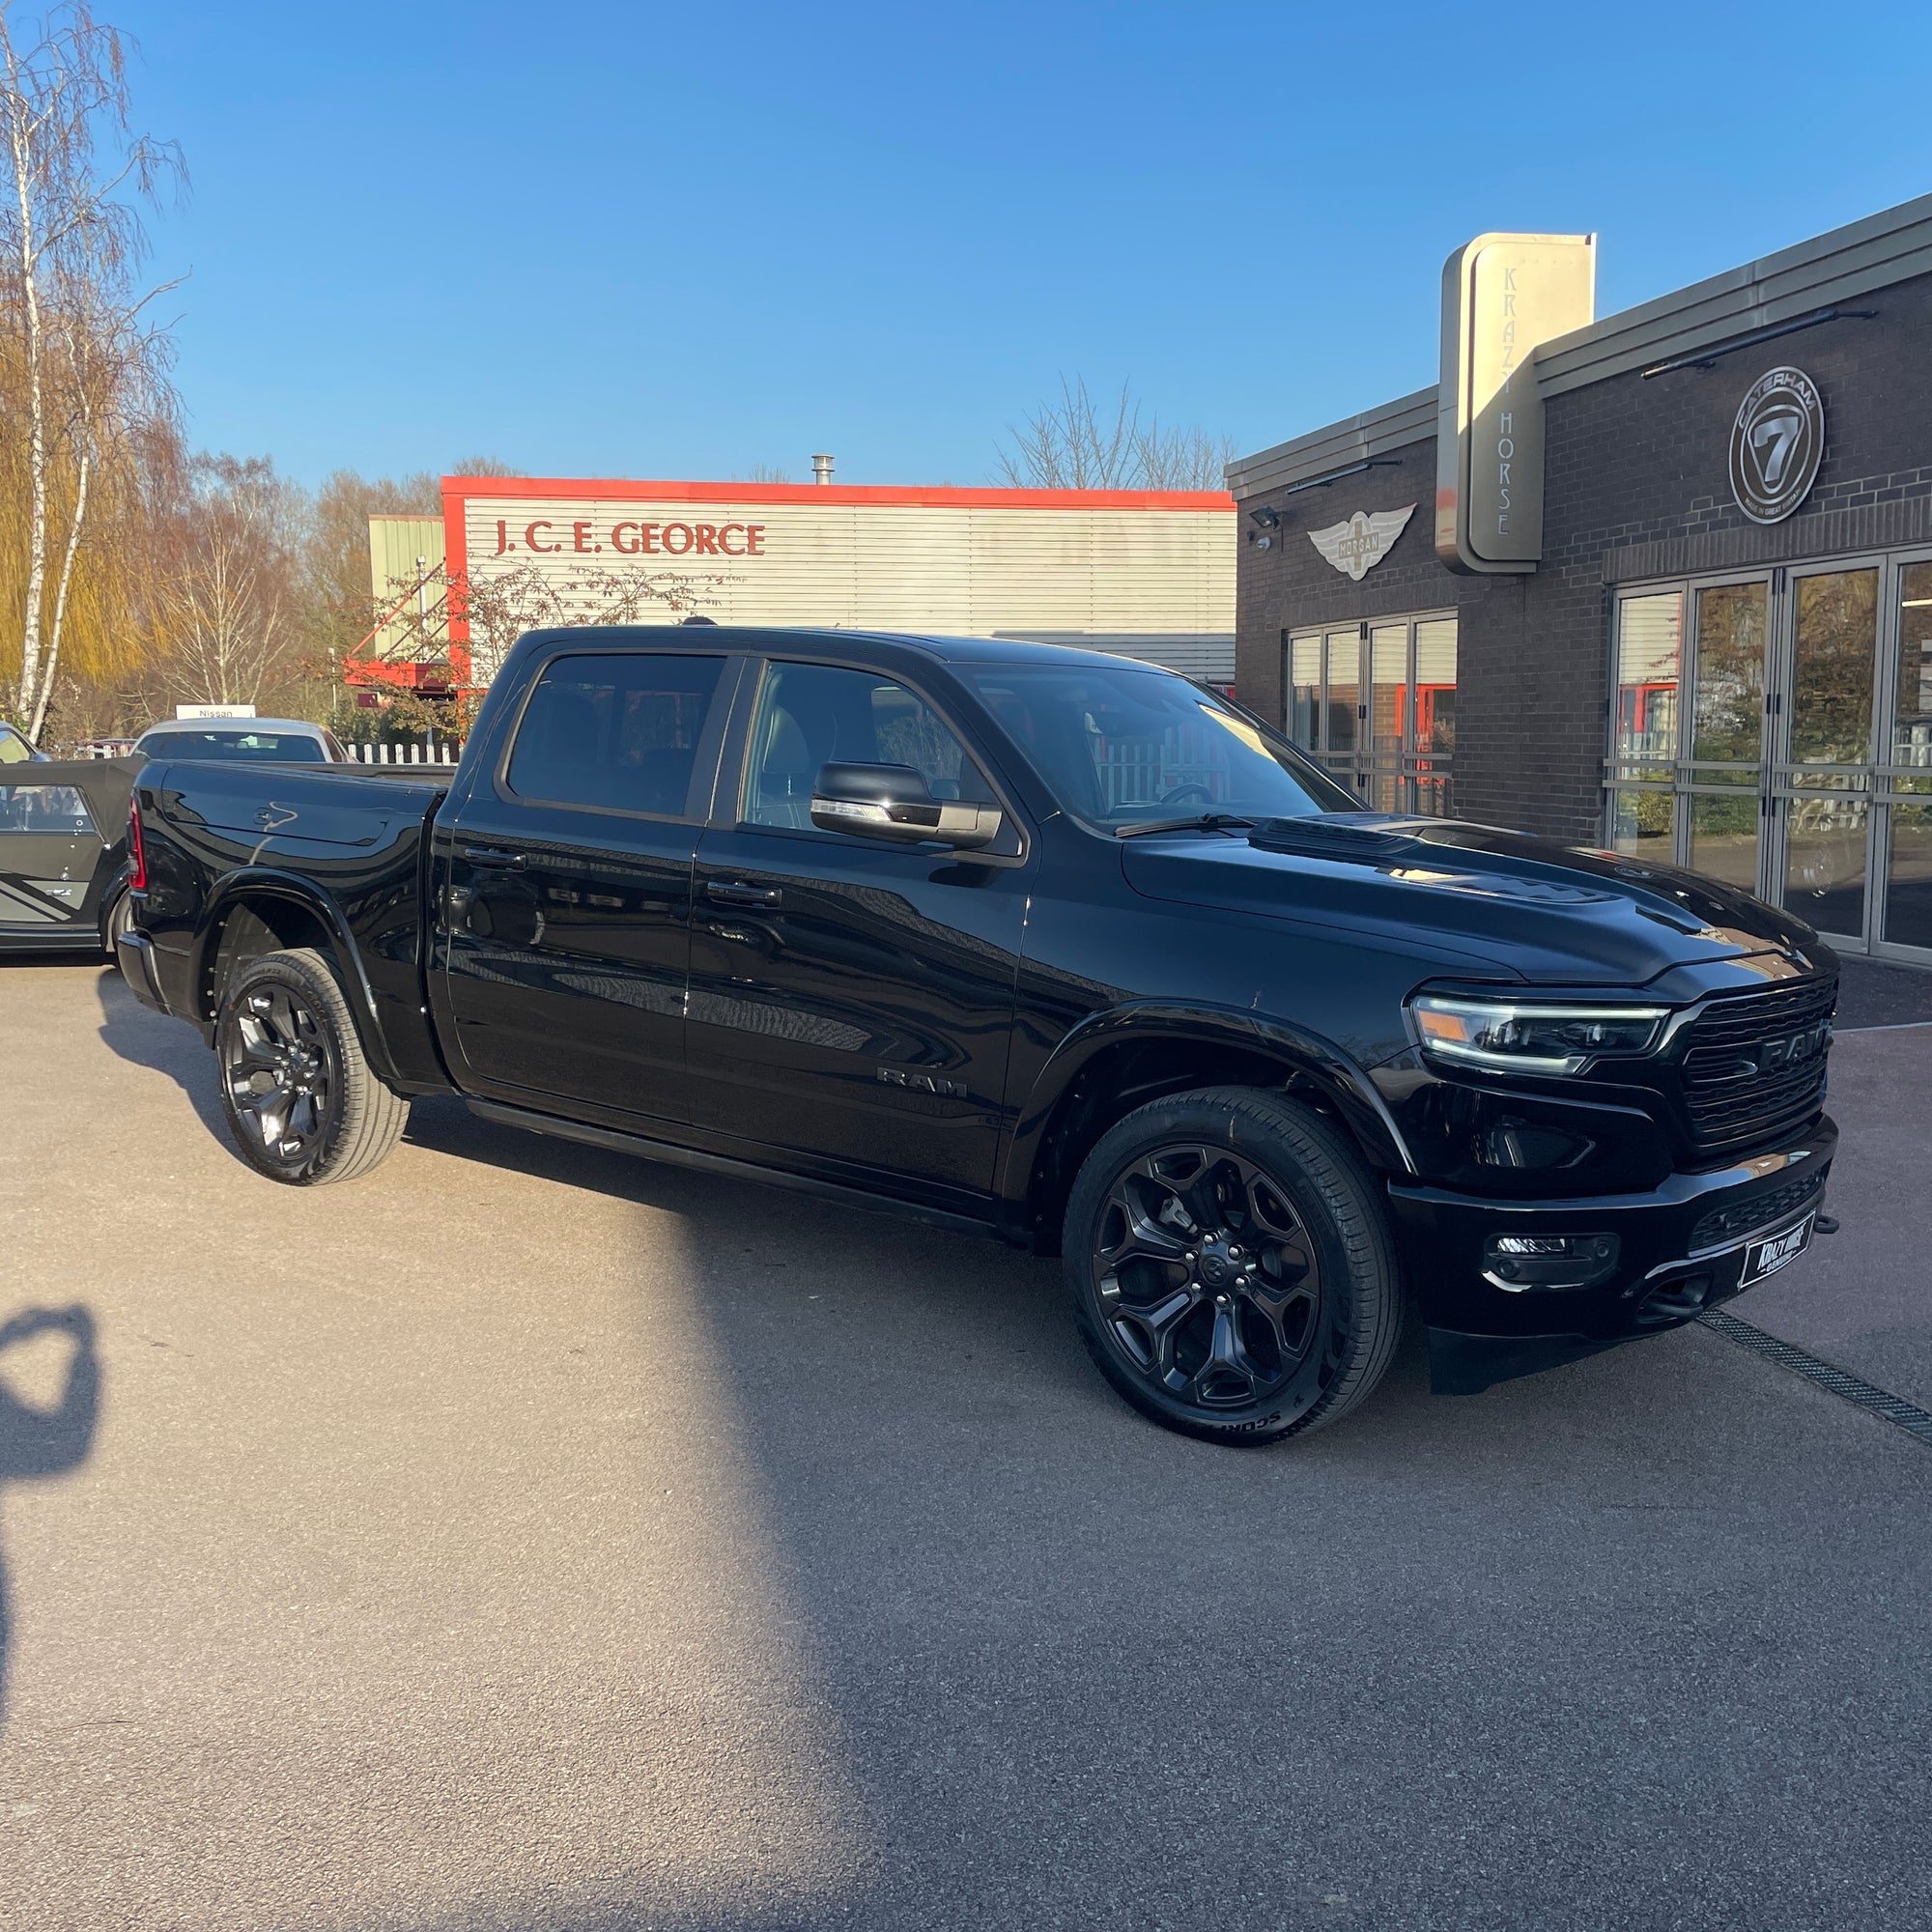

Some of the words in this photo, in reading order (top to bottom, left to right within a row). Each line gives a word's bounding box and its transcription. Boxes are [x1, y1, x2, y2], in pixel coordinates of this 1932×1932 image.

[1501, 268, 1517, 395] KRAZY
[1738, 372, 1817, 430] CATERHAM
[1754, 416, 1799, 482] 7
[1497, 412, 1516, 535] HORSE
[495, 520, 516, 556] J.
[526, 521, 562, 554] C.
[573, 522, 602, 554] E.
[1339, 536, 1378, 555] MORGAN
[199, 709, 233, 718] Nissan
[876, 1066, 968, 1097] RAM
[1757, 1237, 1787, 1270] KRAZY
